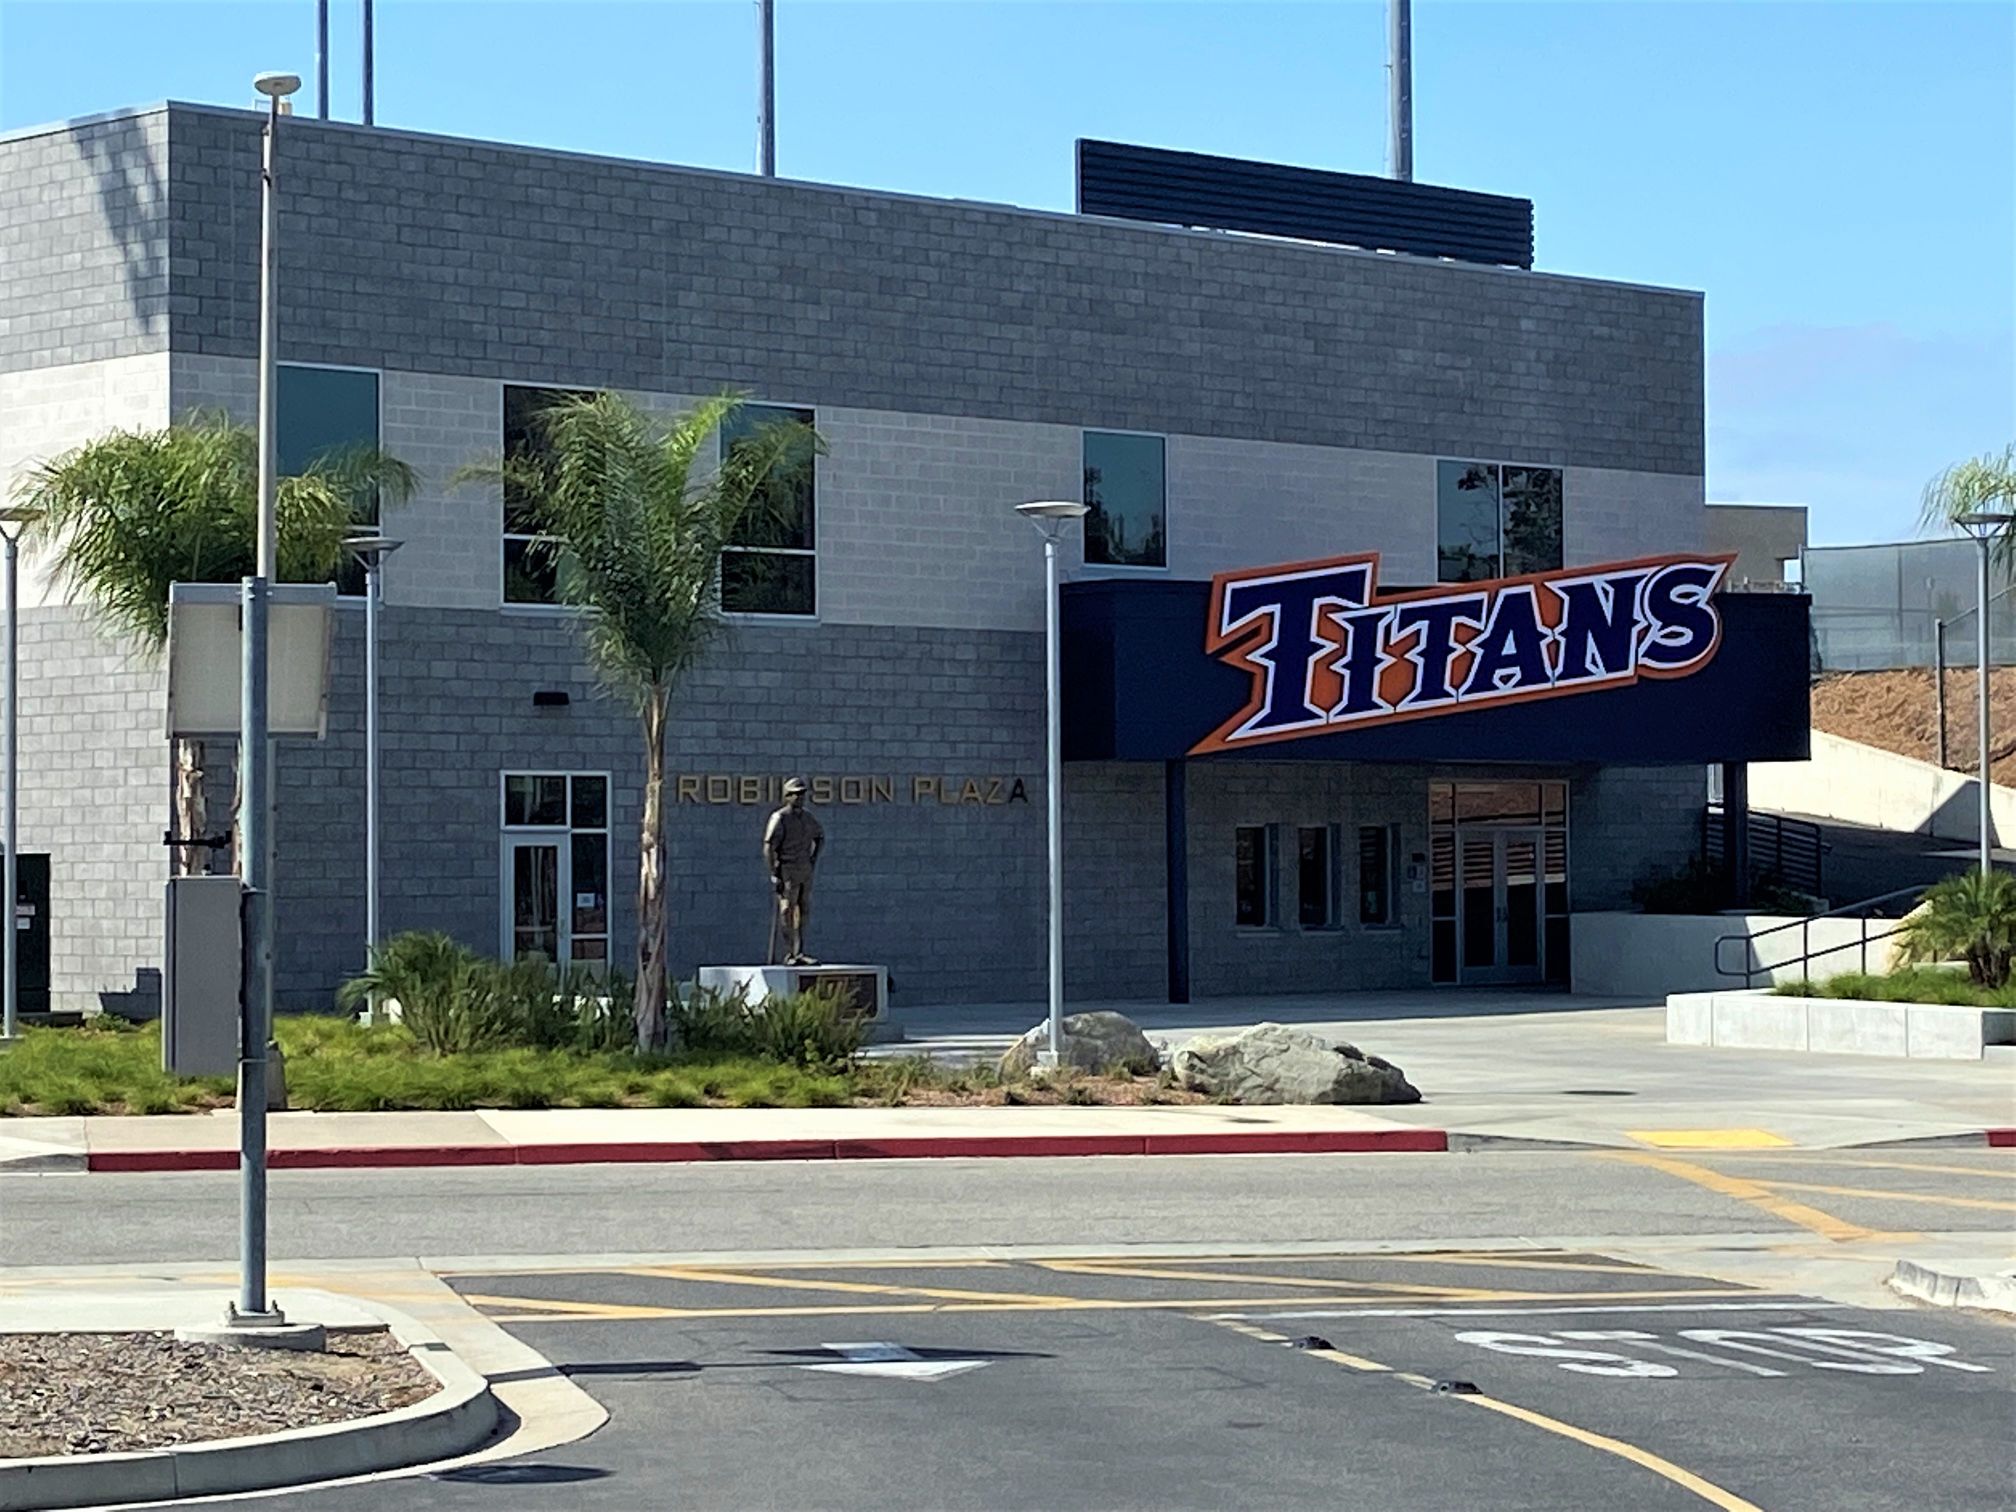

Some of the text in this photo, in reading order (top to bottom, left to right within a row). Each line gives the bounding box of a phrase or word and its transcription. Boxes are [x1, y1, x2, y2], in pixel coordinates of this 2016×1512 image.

[677, 775, 1029, 804] ROBISON PLAZA
[1454, 1327, 1994, 1378] STOP
